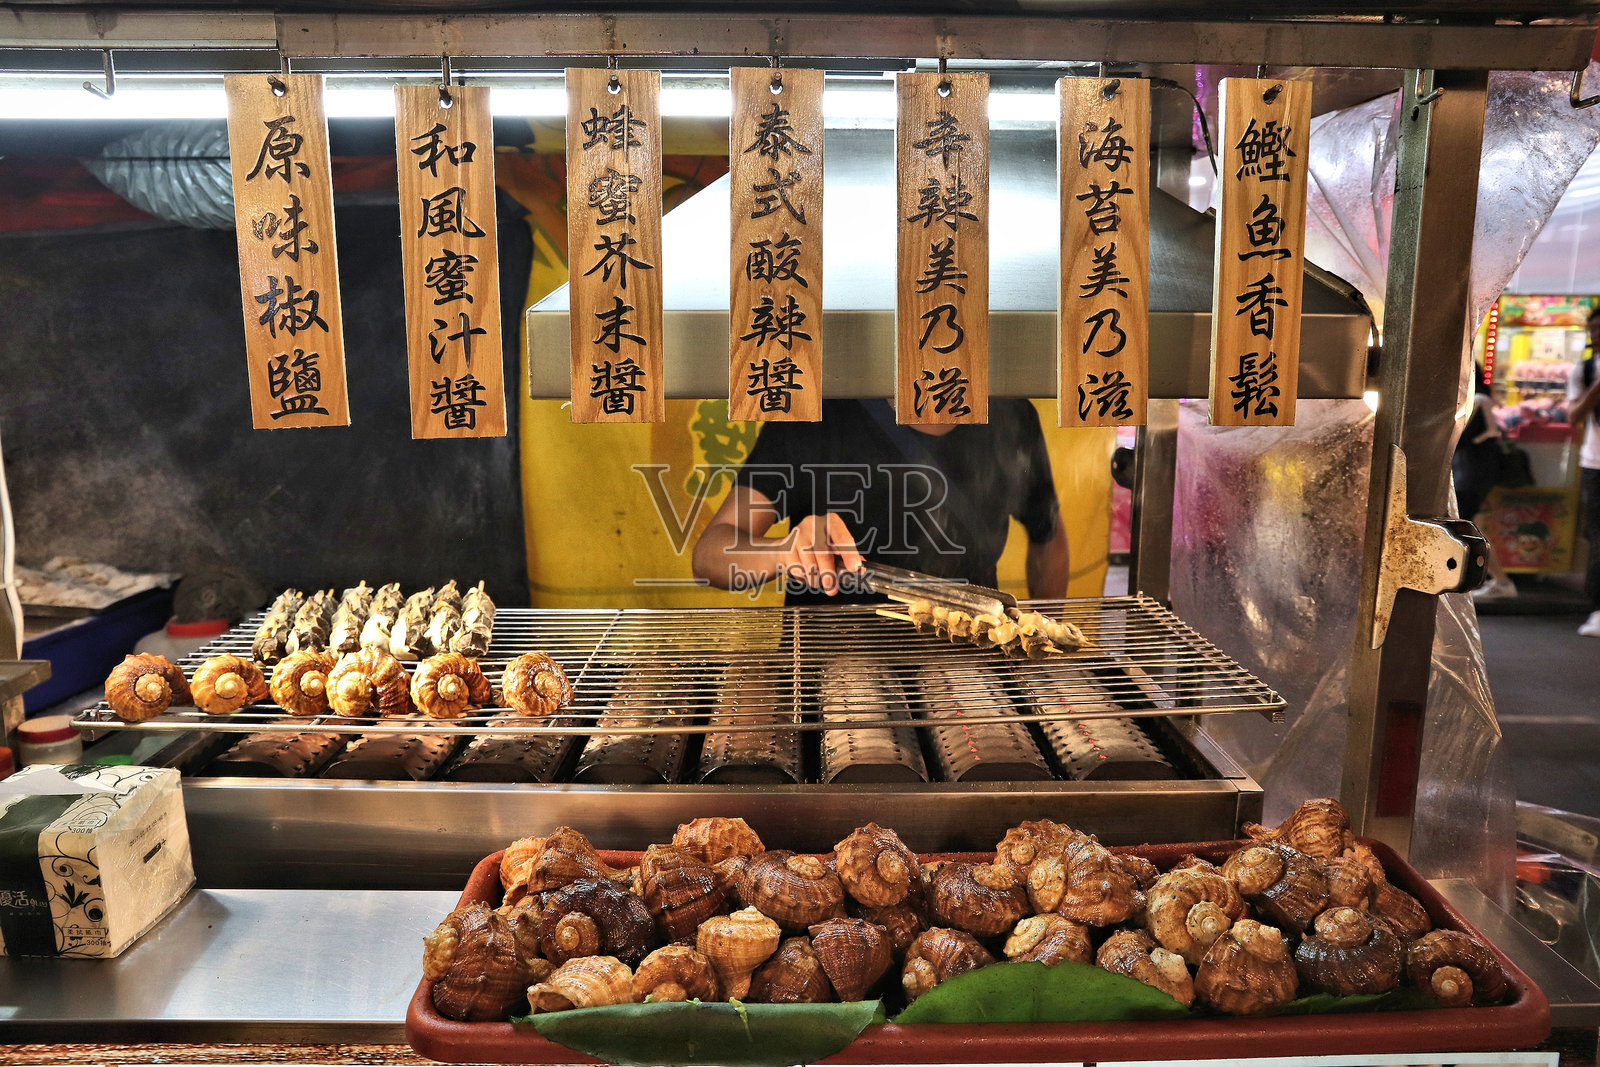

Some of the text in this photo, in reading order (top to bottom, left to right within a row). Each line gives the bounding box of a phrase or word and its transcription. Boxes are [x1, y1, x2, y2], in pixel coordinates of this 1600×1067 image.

[246, 115, 330, 420] 原味椒鹽
[410, 122, 487, 431] 和風蜜汁醬
[580, 104, 655, 416] 蜂蜜芥末醬
[739, 101, 813, 415] 泰式酸辣醬
[906, 110, 980, 419] 辛辣美乃滋
[1075, 120, 1135, 422] 海苔美乃滋
[1227, 118, 1297, 420] 鰹魚香鬆
